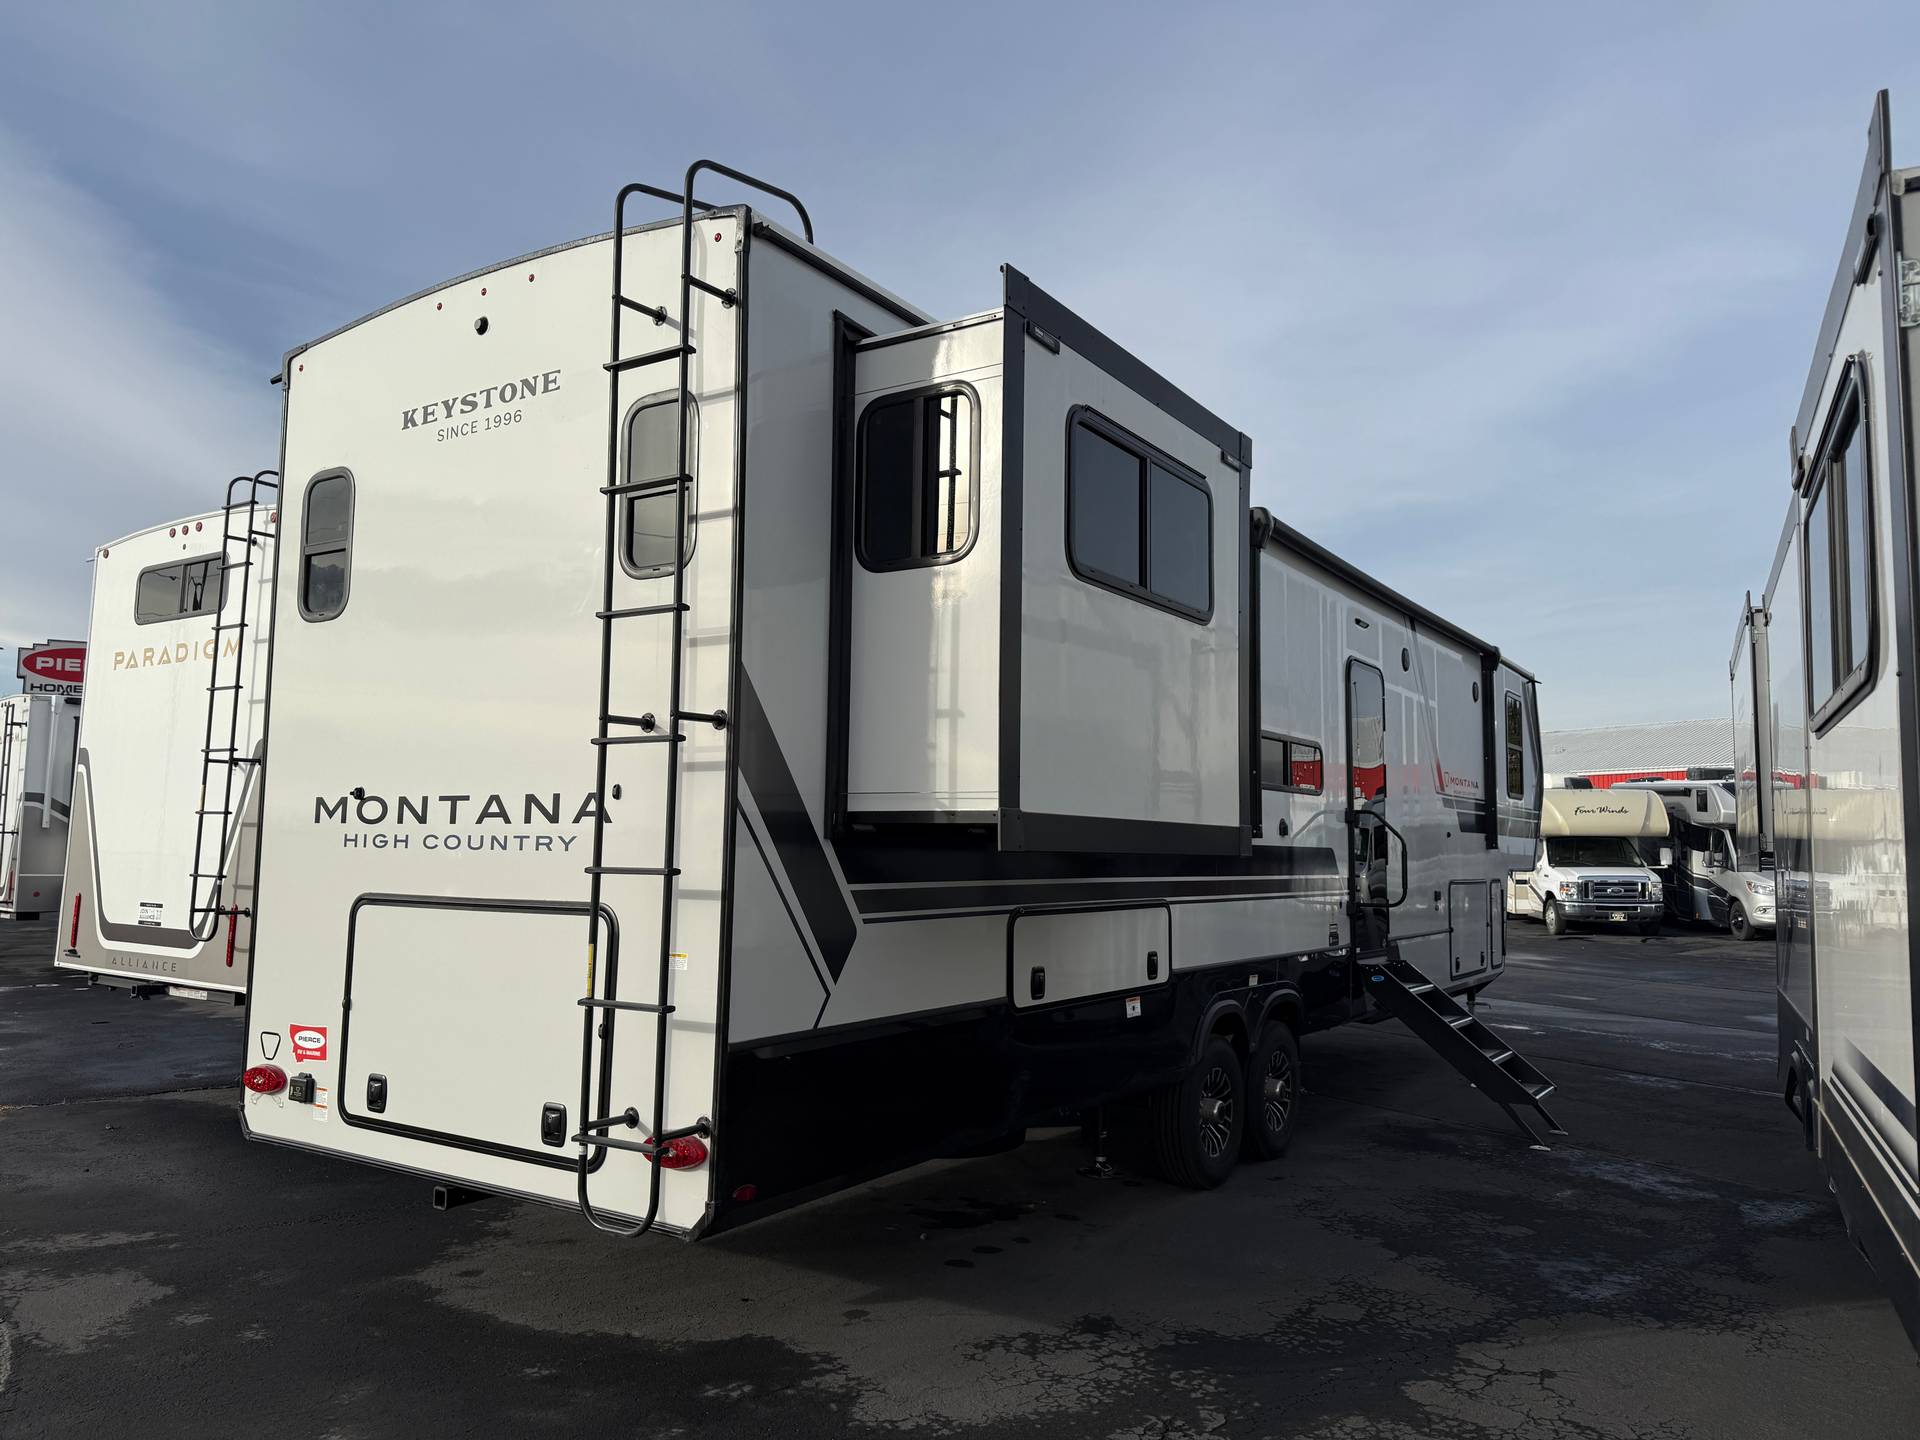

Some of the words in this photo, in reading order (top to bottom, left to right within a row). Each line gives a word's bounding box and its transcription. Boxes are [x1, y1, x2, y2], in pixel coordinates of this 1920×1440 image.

[401, 369, 561, 431] KEYSTONE
[437, 420, 478, 442] SINCE
[484, 409, 523, 431] 1996
[1450, 776, 1479, 790] MONTANA
[314, 792, 613, 825] MONTANA
[1596, 805, 1630, 815] Winds
[343, 833, 409, 849] HIGH
[422, 834, 578, 852] COUNTRY
[111, 956, 178, 973] ALLIANCE
[298, 1035, 321, 1044] PIERCE
